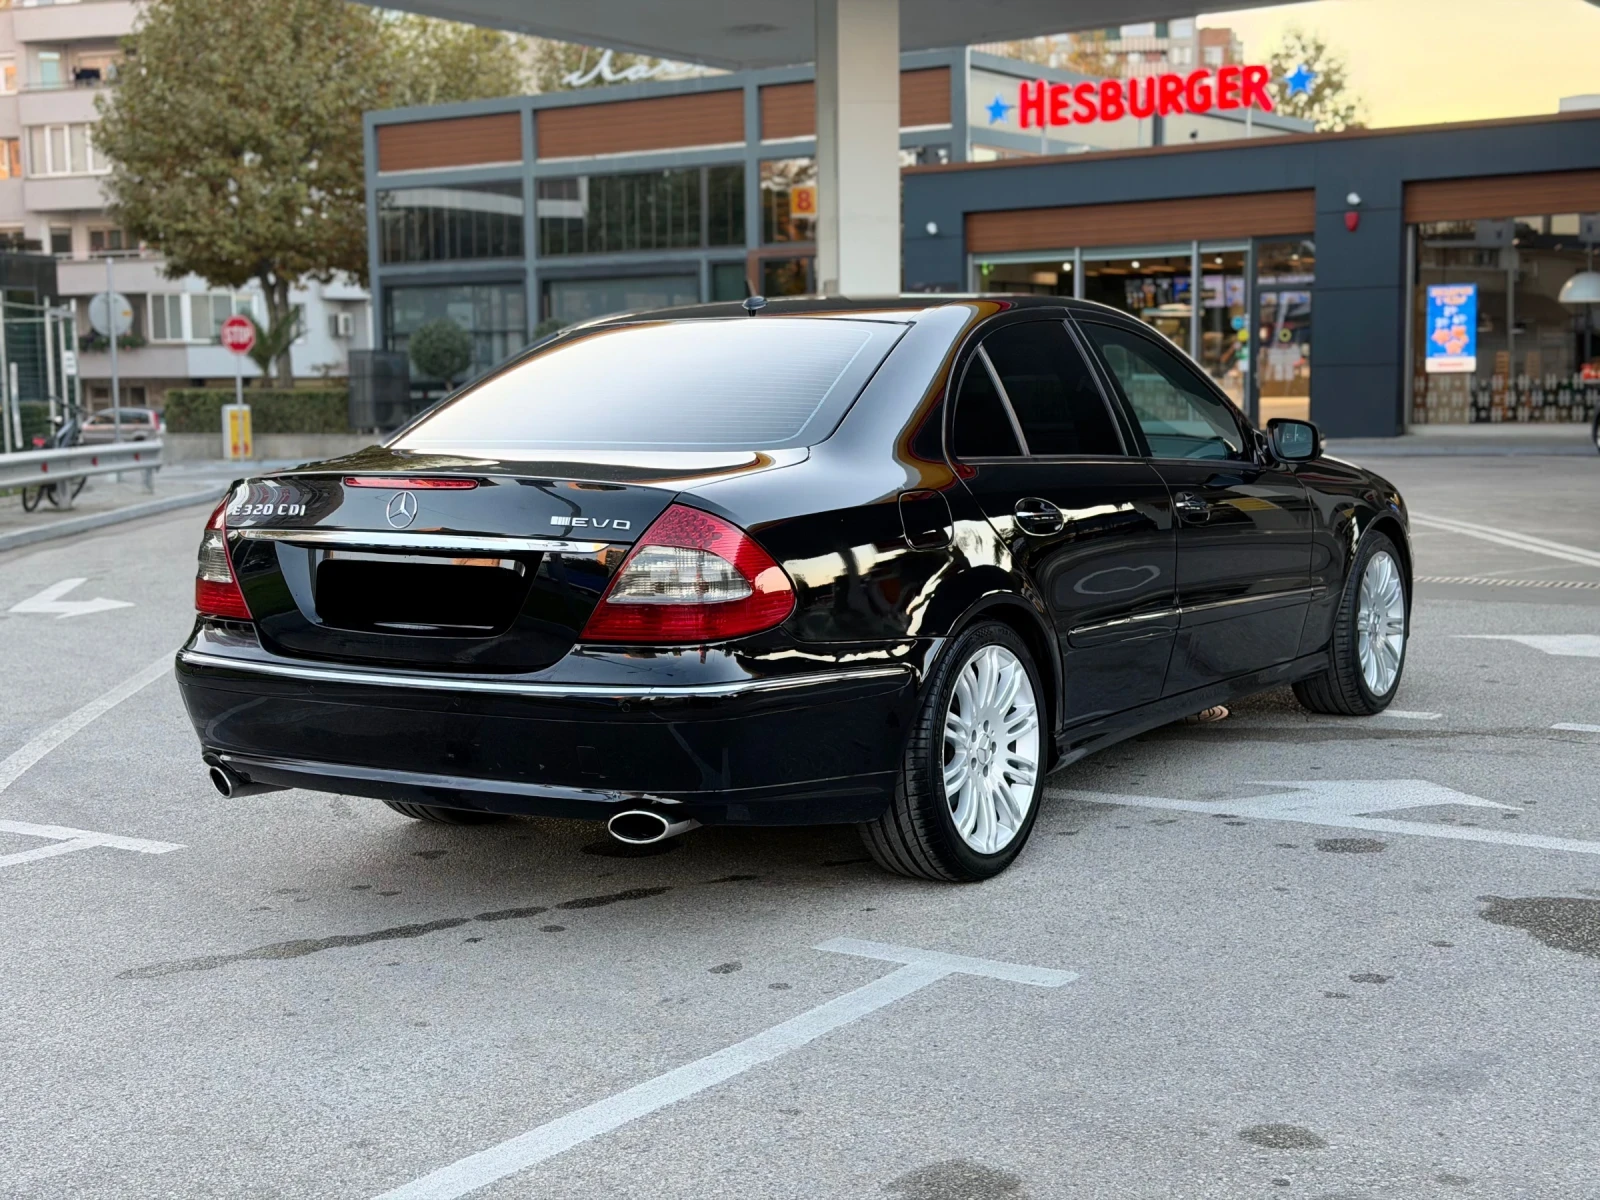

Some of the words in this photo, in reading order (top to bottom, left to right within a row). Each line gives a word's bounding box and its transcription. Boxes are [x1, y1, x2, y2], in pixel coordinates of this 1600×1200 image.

[1019, 65, 1274, 130] HESBURGER
[798, 190, 811, 210] 8
[223, 326, 253, 343] STOP
[277, 503, 306, 516] CDI
[571, 517, 631, 531] EVO
